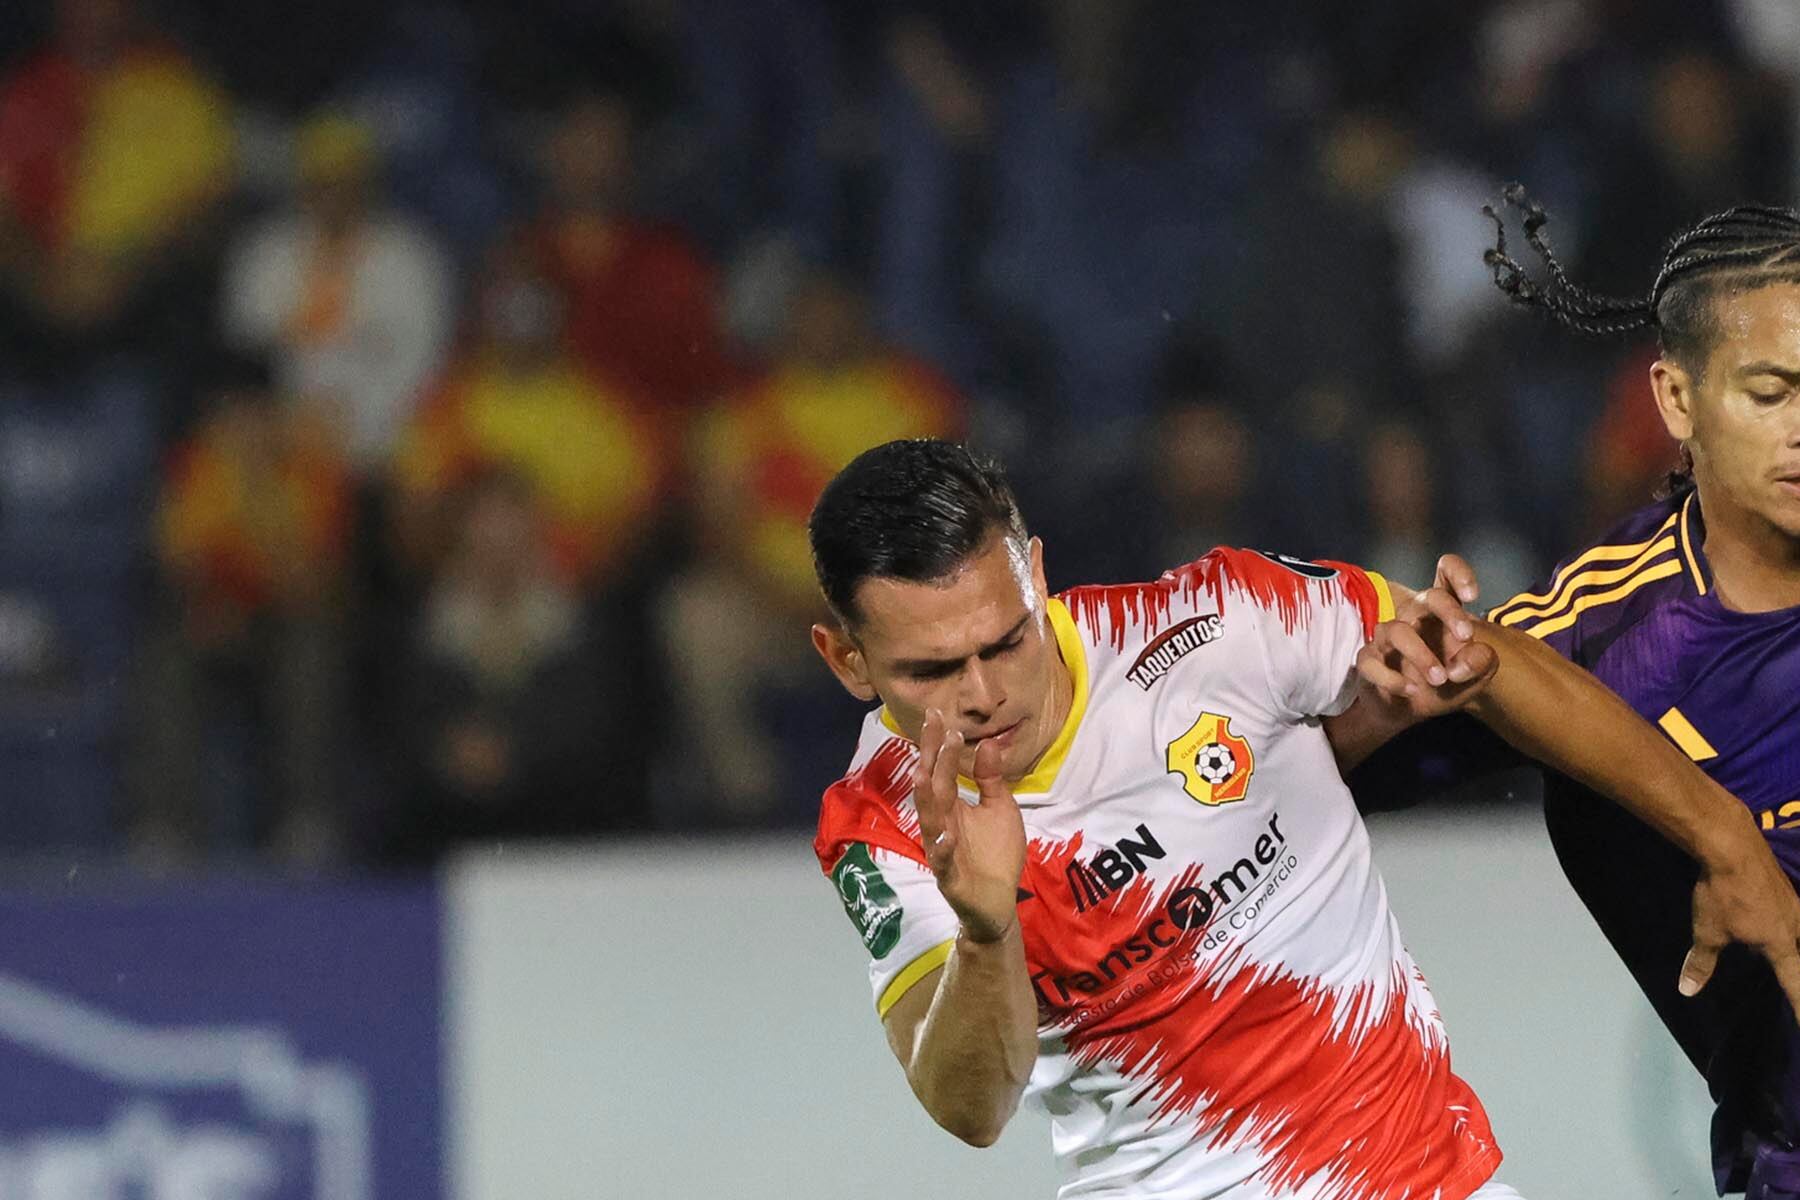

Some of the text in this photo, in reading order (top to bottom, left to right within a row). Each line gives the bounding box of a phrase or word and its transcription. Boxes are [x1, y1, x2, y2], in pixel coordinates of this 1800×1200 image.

[1128, 615, 1225, 691] TAQUERITOS
[1146, 951, 1201, 987] Bolsa
[1202, 930, 1229, 951] de
[1229, 855, 1299, 931] Comercio
